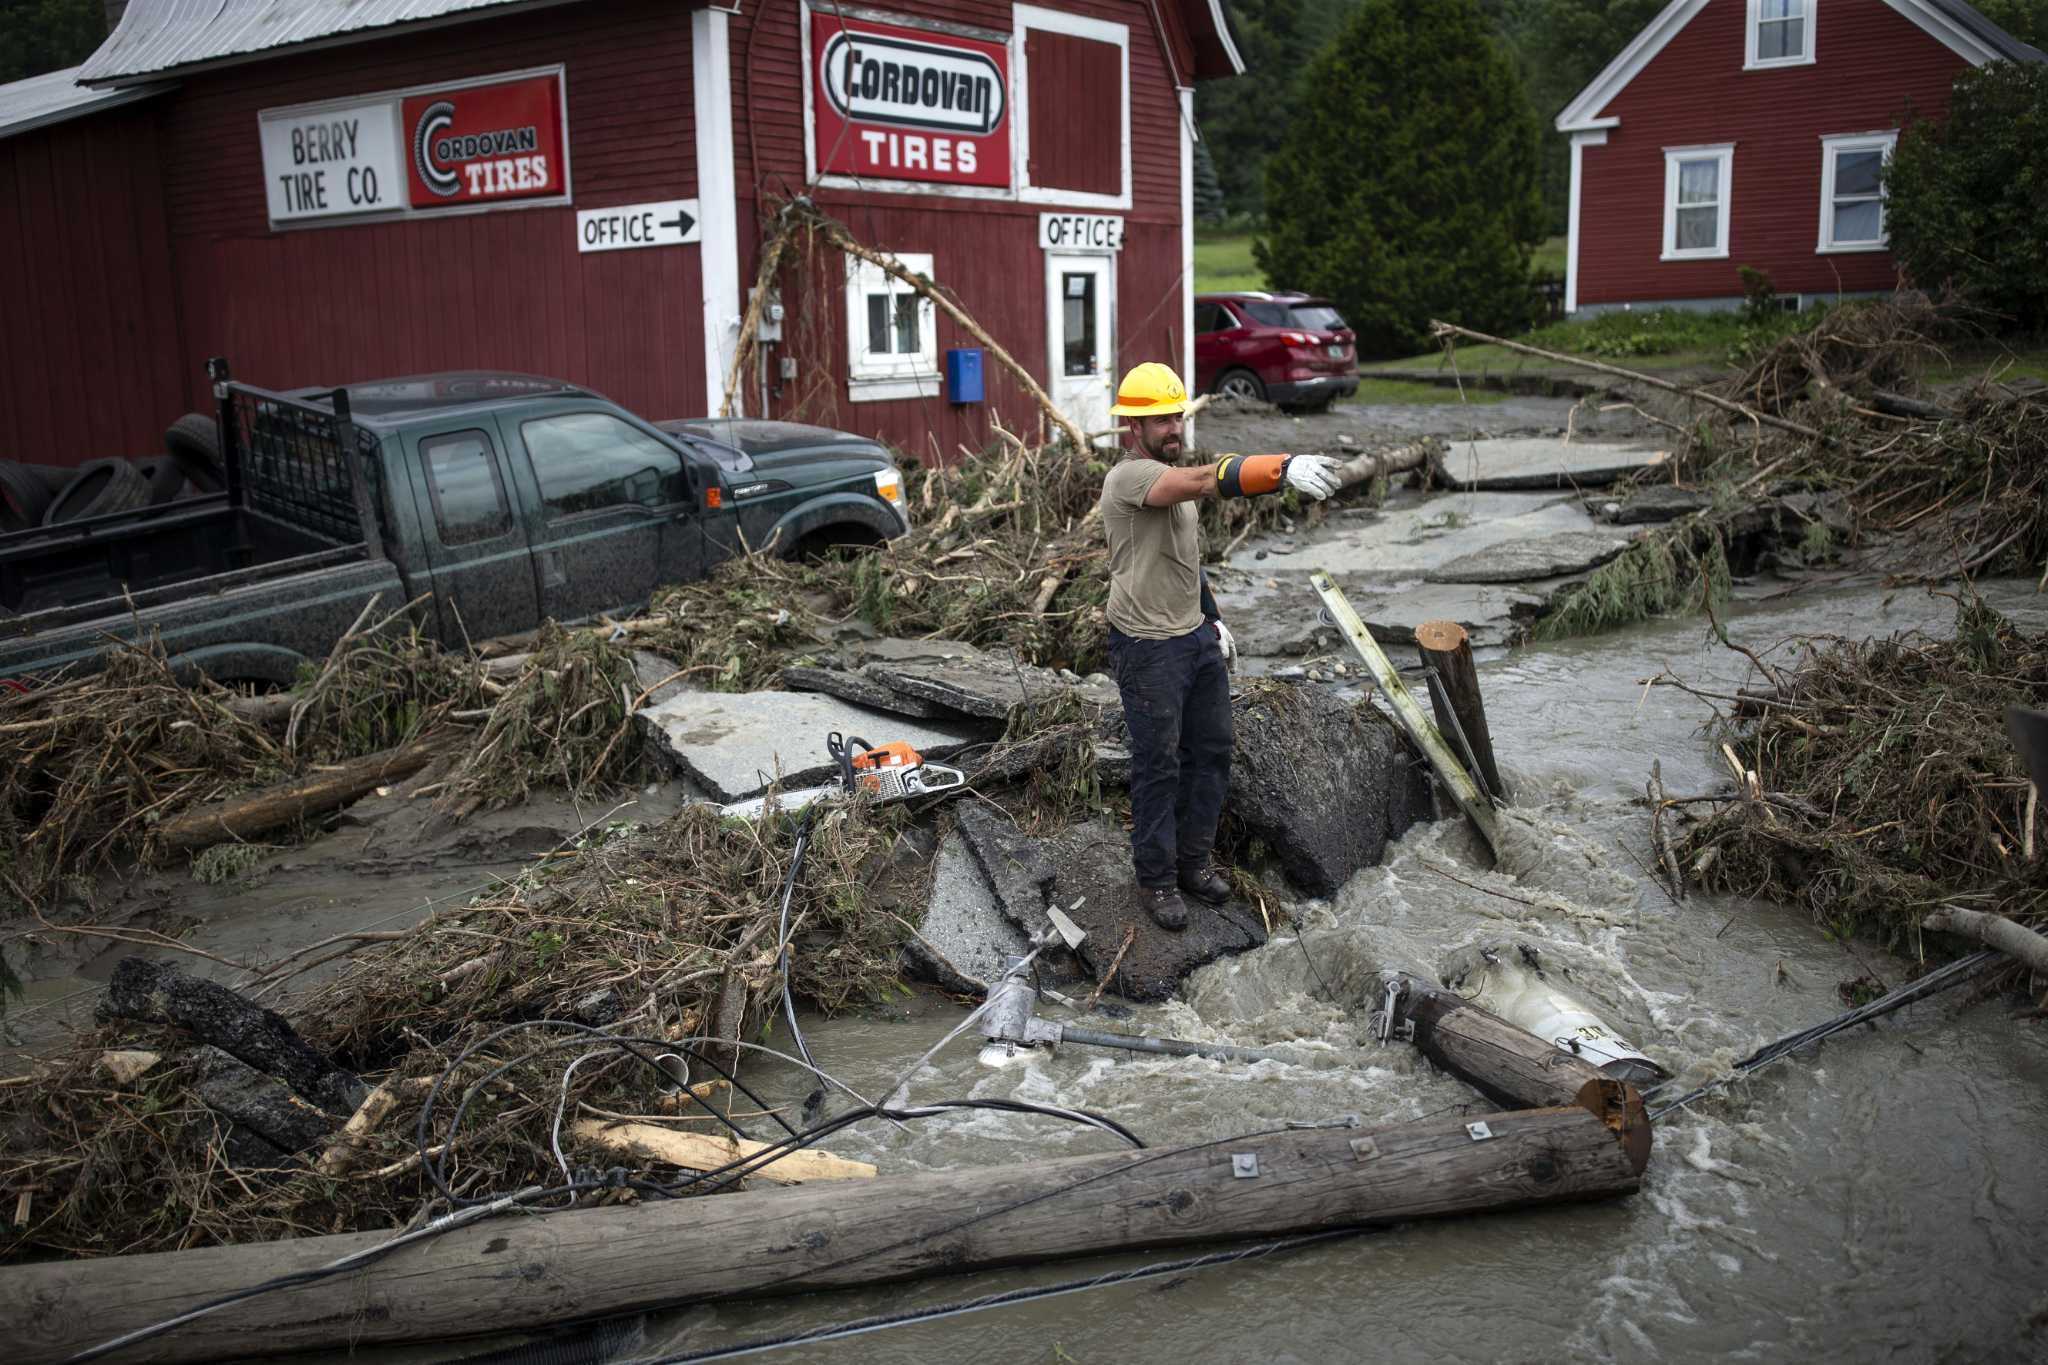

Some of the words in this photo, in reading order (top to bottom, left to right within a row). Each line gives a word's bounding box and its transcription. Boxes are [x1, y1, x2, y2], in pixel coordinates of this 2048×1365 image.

[292, 119, 358, 165] BERRY
[861, 130, 977, 173] TIRES
[280, 170, 328, 213] TIRE
[347, 165, 382, 205] CO.
[465, 155, 548, 195] TIRES
[584, 213, 655, 245] OFFICE
[1048, 216, 1116, 248] OFFICE
